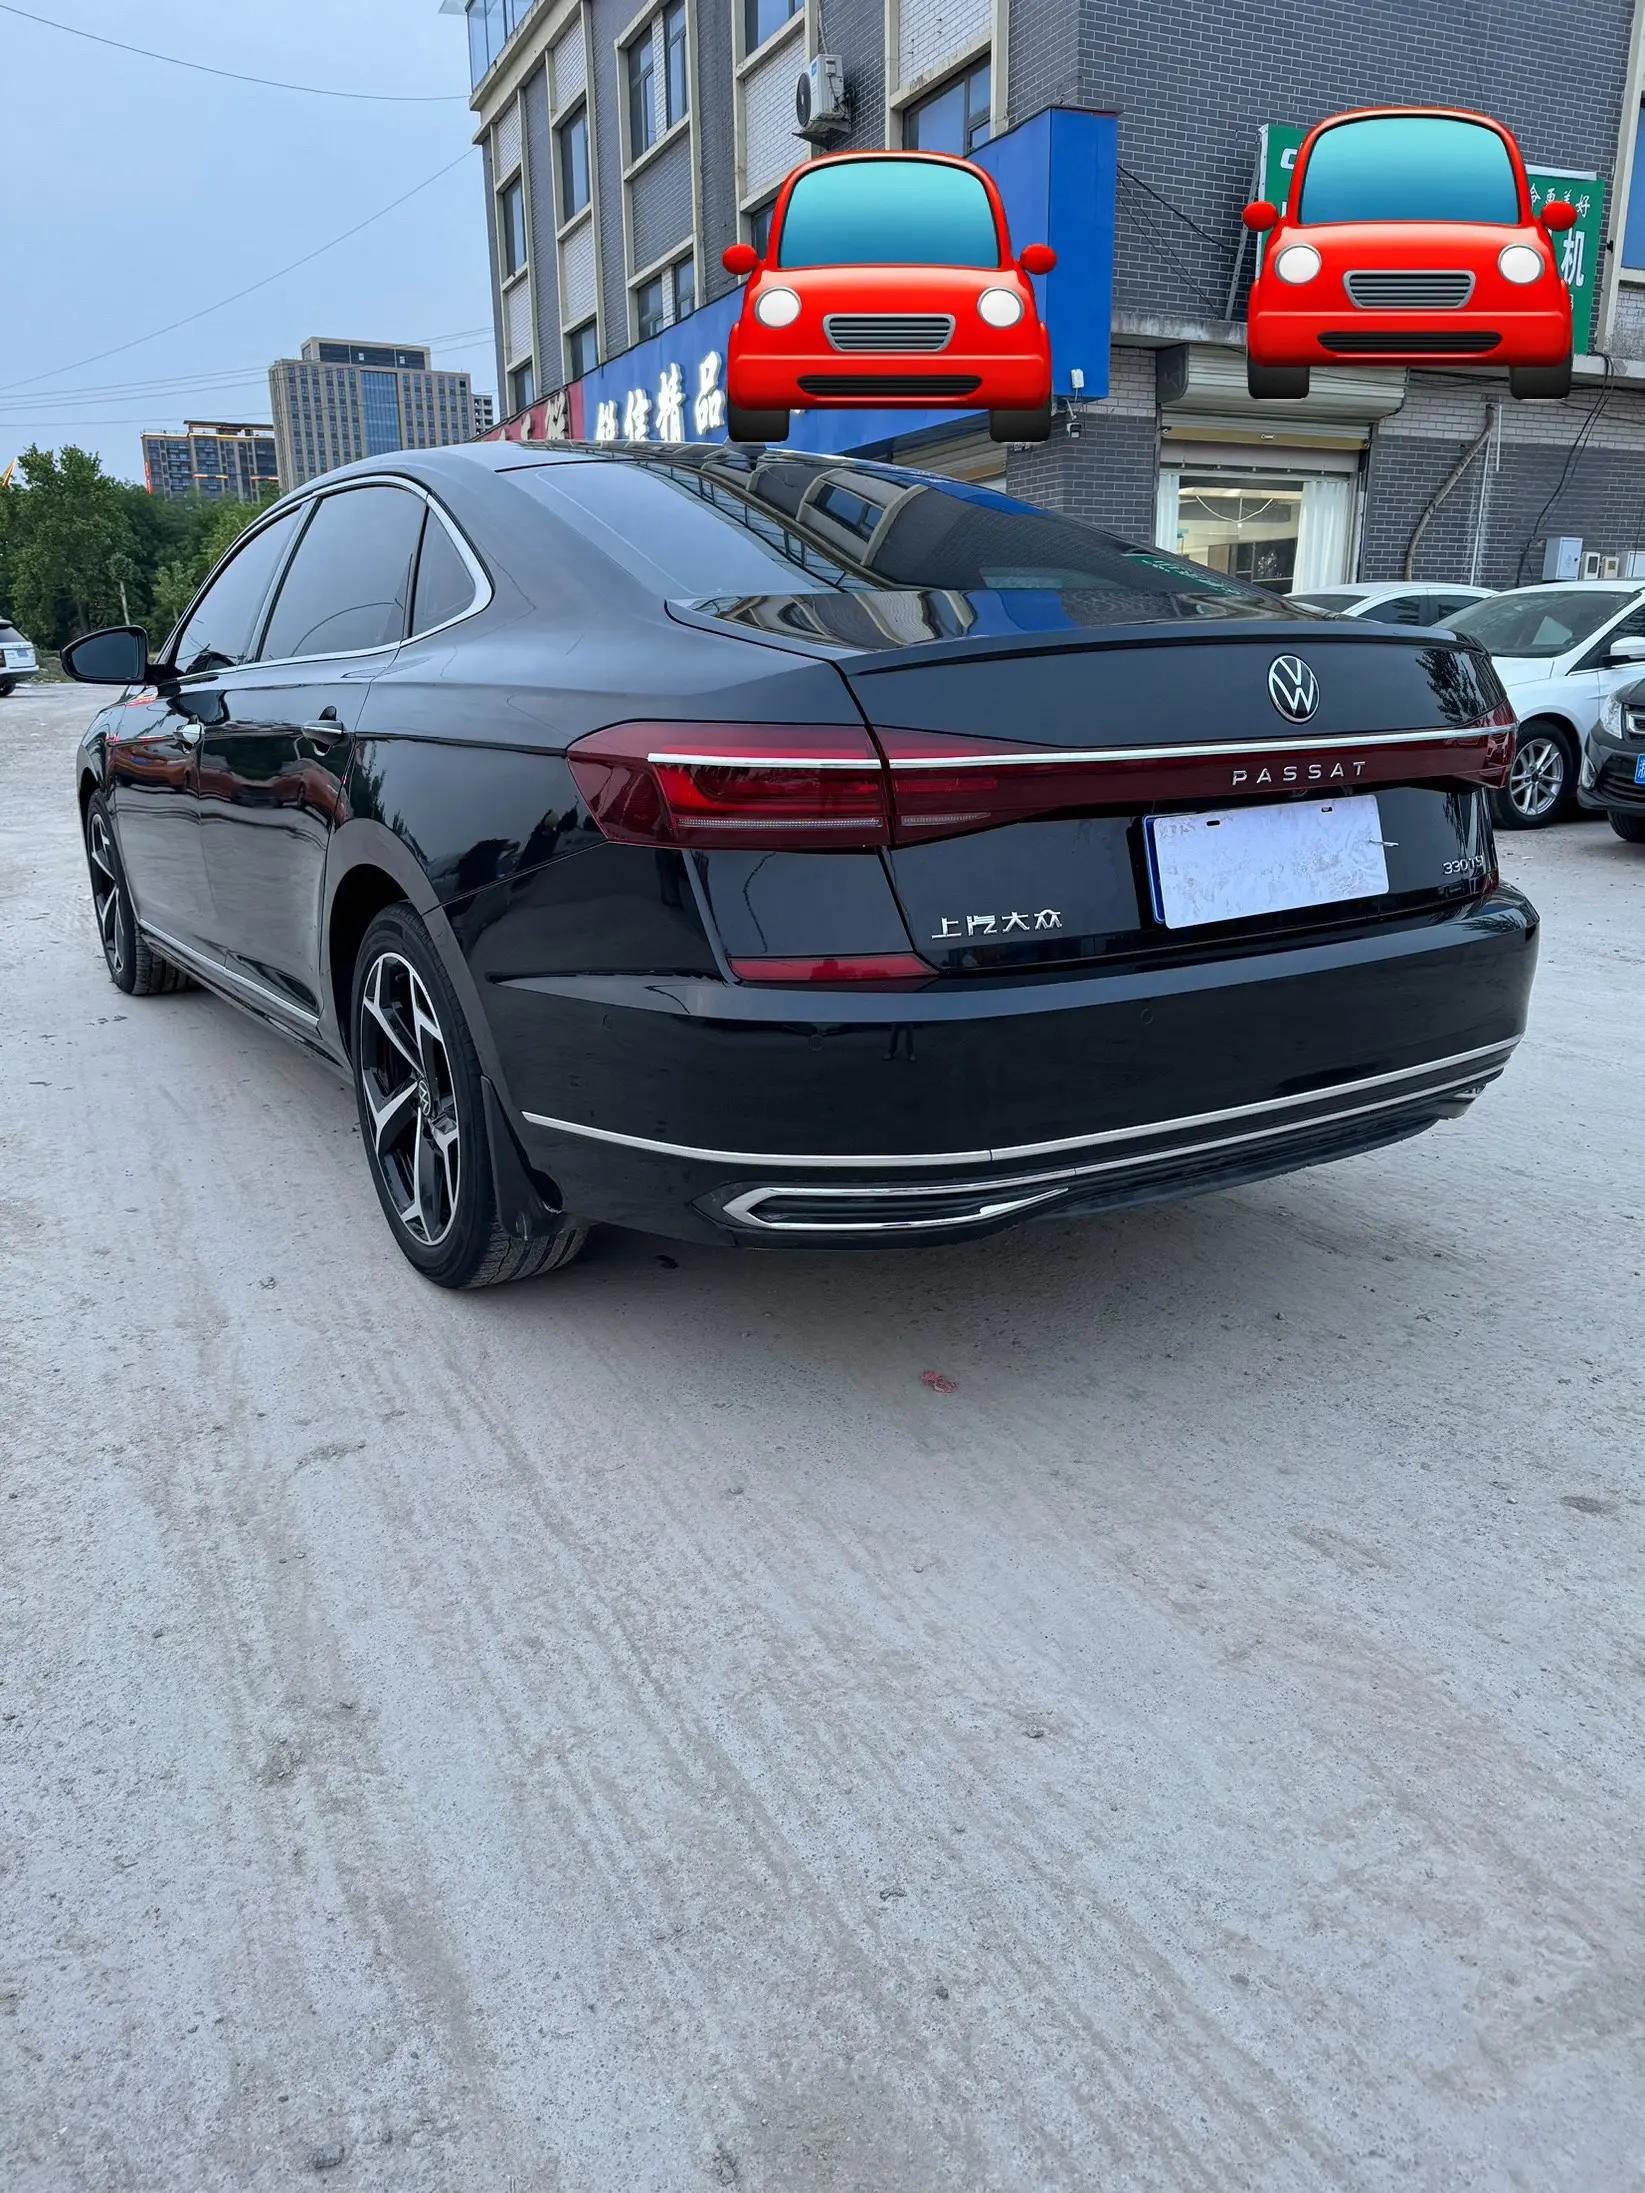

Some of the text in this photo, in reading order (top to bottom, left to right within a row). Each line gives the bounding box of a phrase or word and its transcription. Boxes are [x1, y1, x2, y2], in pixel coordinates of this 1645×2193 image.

[1561, 228, 1585, 287] 机
[1232, 761, 1367, 786] PASSAT
[931, 909, 1063, 939] 上汽大众
